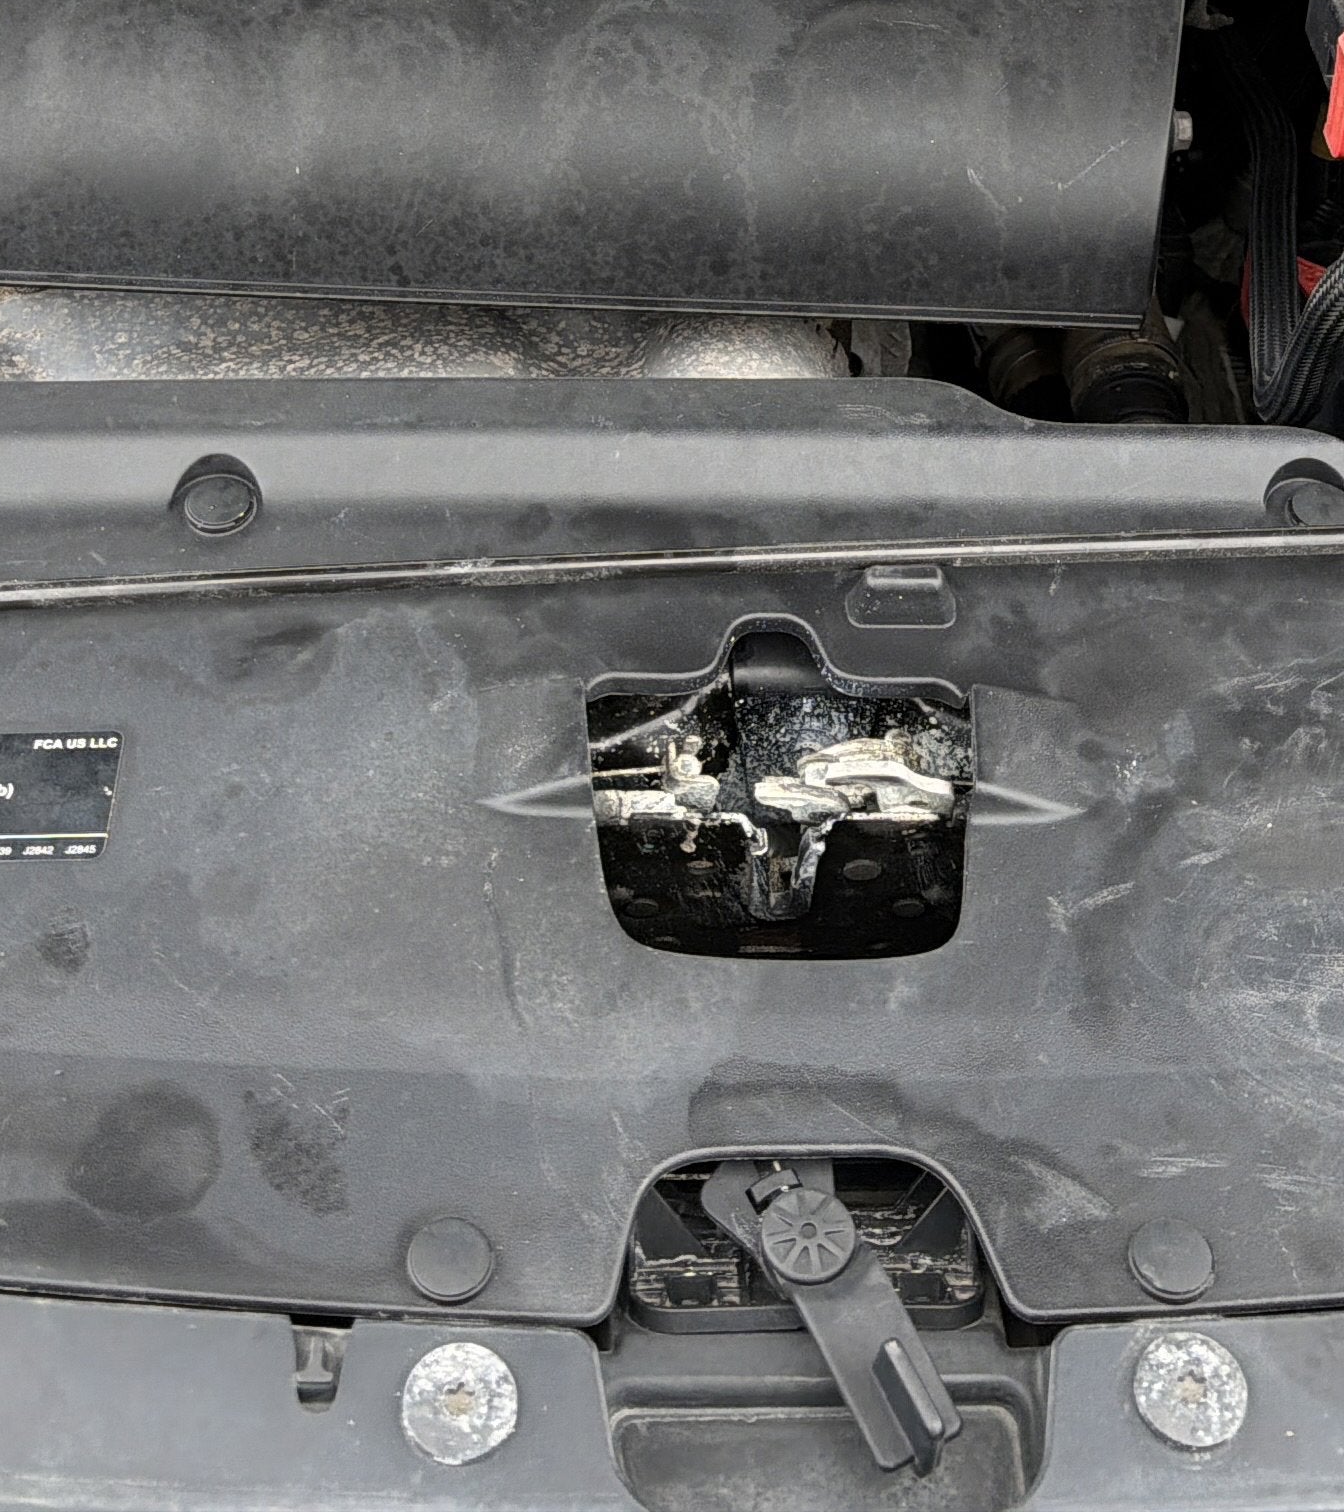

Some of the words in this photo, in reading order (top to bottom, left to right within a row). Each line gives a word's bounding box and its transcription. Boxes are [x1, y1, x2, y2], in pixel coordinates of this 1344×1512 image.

[32, 738, 64, 751] FCA
[66, 738, 87, 750] US
[89, 736, 118, 749] LLC
